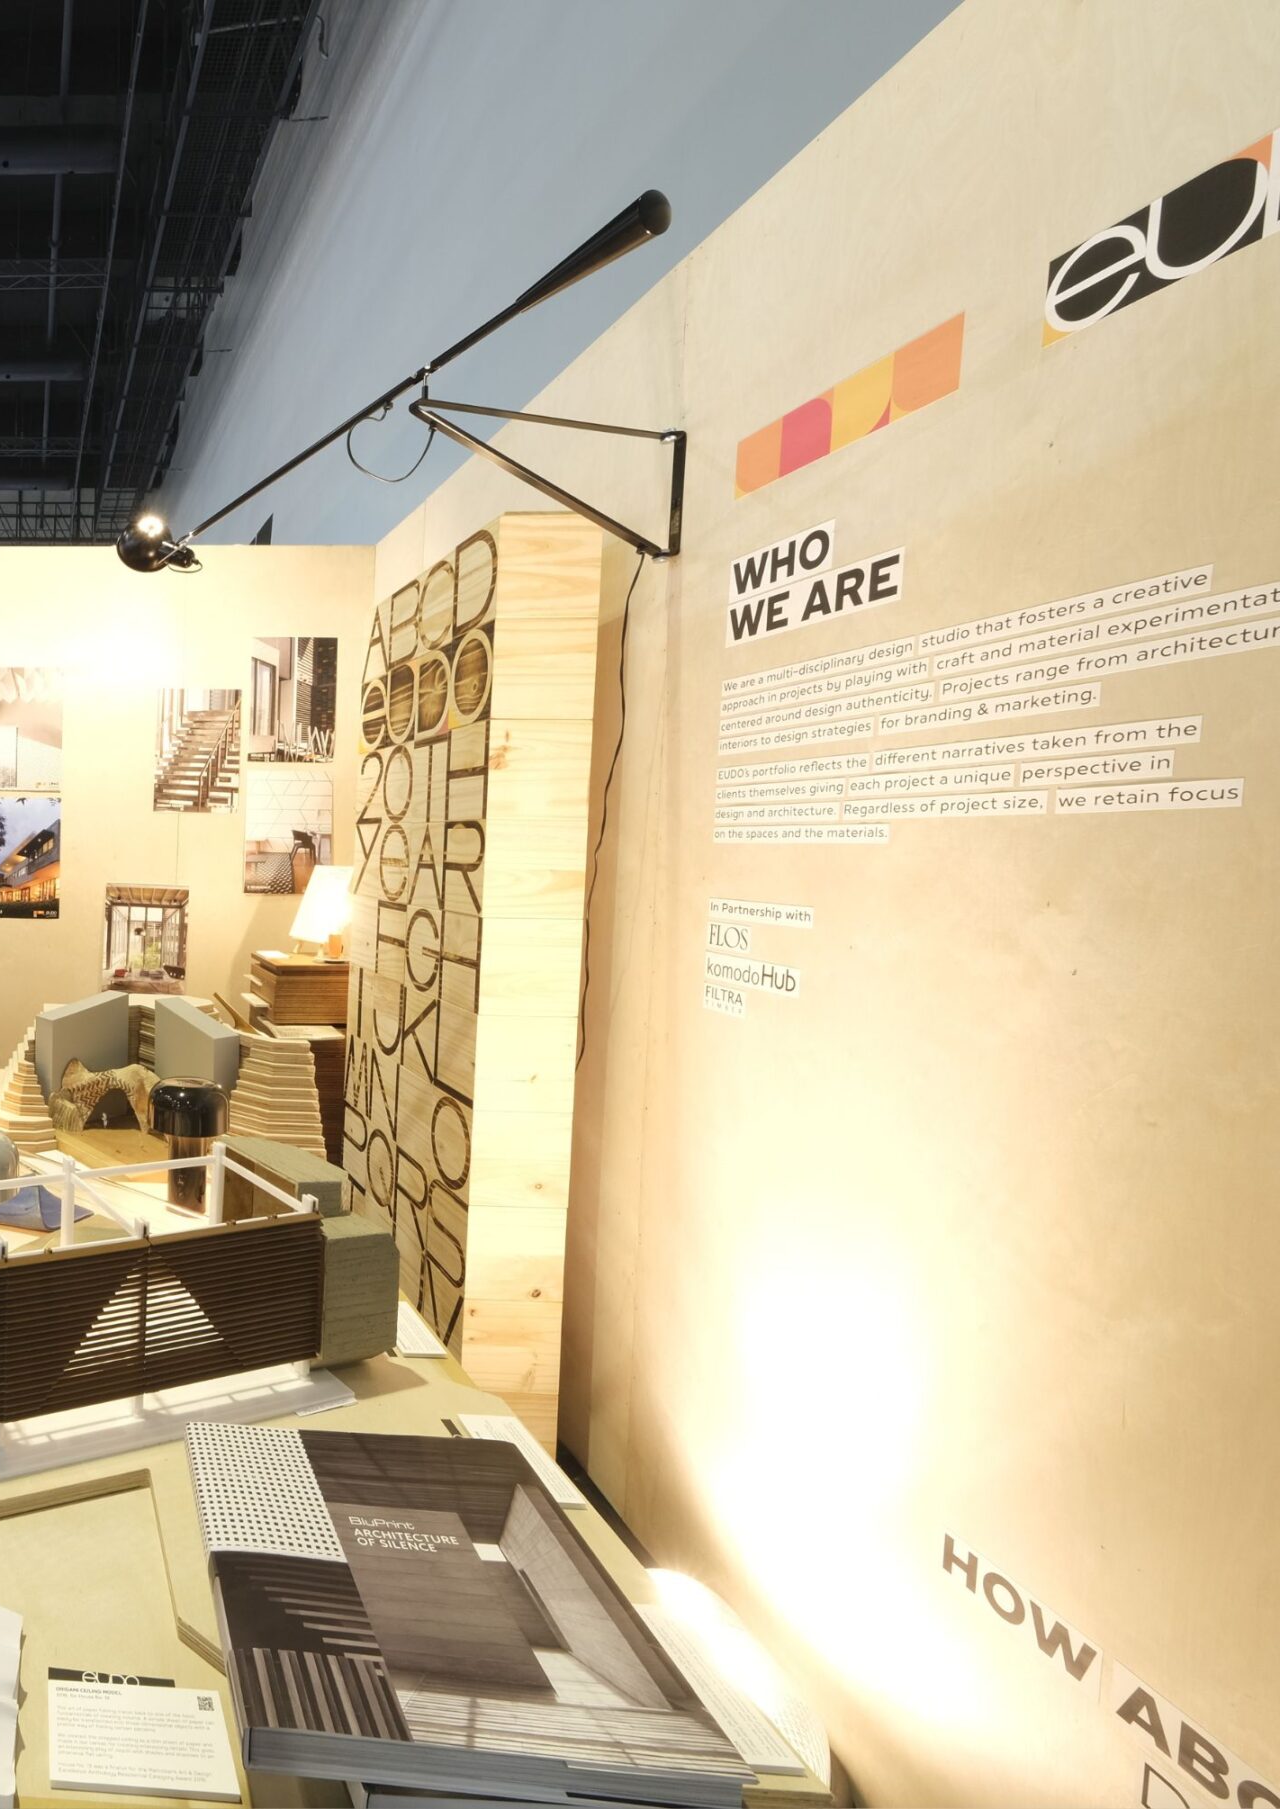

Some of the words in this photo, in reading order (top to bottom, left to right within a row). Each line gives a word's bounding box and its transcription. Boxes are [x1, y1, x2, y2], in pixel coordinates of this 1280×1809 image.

[733, 529, 830, 595] WHO
[730, 590, 790, 641] WE
[801, 553, 900, 621] ARE
[724, 681, 737, 691] We
[741, 678, 755, 688] are
[758, 676, 763, 684] a
[767, 654, 864, 683] multi-disciplinary
[869, 643, 912, 661] design
[922, 628, 970, 648] studio
[976, 617, 1012, 635] that
[1019, 600, 1085, 626] fosters
[1093, 597, 1104, 608] a
[1112, 573, 1207, 604] creative
[722, 693, 765, 712] approach
[768, 688, 776, 701] in
[780, 683, 822, 702] projects
[827, 677, 841, 692] by
[846, 668, 892, 689] playing
[897, 661, 927, 676] with
[937, 653, 974, 669] craft
[981, 643, 1012, 661] and
[1019, 625, 1099, 653] material
[721, 715, 762, 731] centered
[766, 708, 801, 724] around
[805, 702, 842, 717] design
[846, 686, 932, 710] authenticity.
[943, 672, 1008, 695] Projects
[1016, 664, 1069, 682] range
[1078, 653, 1127, 671] from
[720, 737, 757, 750] interiors
[761, 734, 771, 744] to
[774, 730, 808, 743] design
[812, 722, 871, 738] strategies
[882, 715, 899, 728] for
[905, 704, 972, 725] branding
[978, 700, 988, 715] &
[995, 687, 1096, 712] marketing.
[752, 763, 796, 778] portfolio
[799, 759, 842, 772] reflects
[847, 757, 866, 768] the
[875, 748, 936, 765] different
[942, 740, 1024, 758] narratives
[1032, 732, 1086, 750] taken
[1095, 729, 1146, 744] from
[1157, 722, 1197, 738] the
[717, 789, 746, 799] clients
[749, 785, 806, 797] themselves
[810, 782, 843, 796] giving
[850, 778, 880, 790] each
[885, 774, 935, 791] project
[940, 775, 947, 785] a
[954, 770, 1011, 785] unique
[1023, 758, 1141, 782] perspective
[1151, 755, 1170, 770] in
[716, 807, 744, 820] design
[747, 805, 765, 817] and
[844, 802, 915, 817] Regardless
[920, 799, 936, 812] of
[940, 797, 997, 814] project
[1059, 796, 1086, 806] we
[1095, 789, 1159, 805] retain
[1169, 786, 1238, 802] focus
[728, 828, 743, 838] the
[746, 830, 778, 840] spaces
[782, 827, 801, 838] and
[805, 827, 823, 837] the
[827, 826, 887, 837] materials.
[710, 902, 719, 911] In
[721, 903, 782, 920] Partnership
[786, 910, 811, 921] with
[709, 924, 748, 950] FLOS
[706, 957, 796, 992] komodoHub
[705, 985, 743, 1006] FILTRA
[348, 1516, 415, 1530] BluPrint
[355, 1528, 459, 1545] ARCHITECTURE
[357, 1537, 375, 1546] OF
[379, 1539, 437, 1552] SILENCE
[942, 1533, 1098, 1681] HOW
